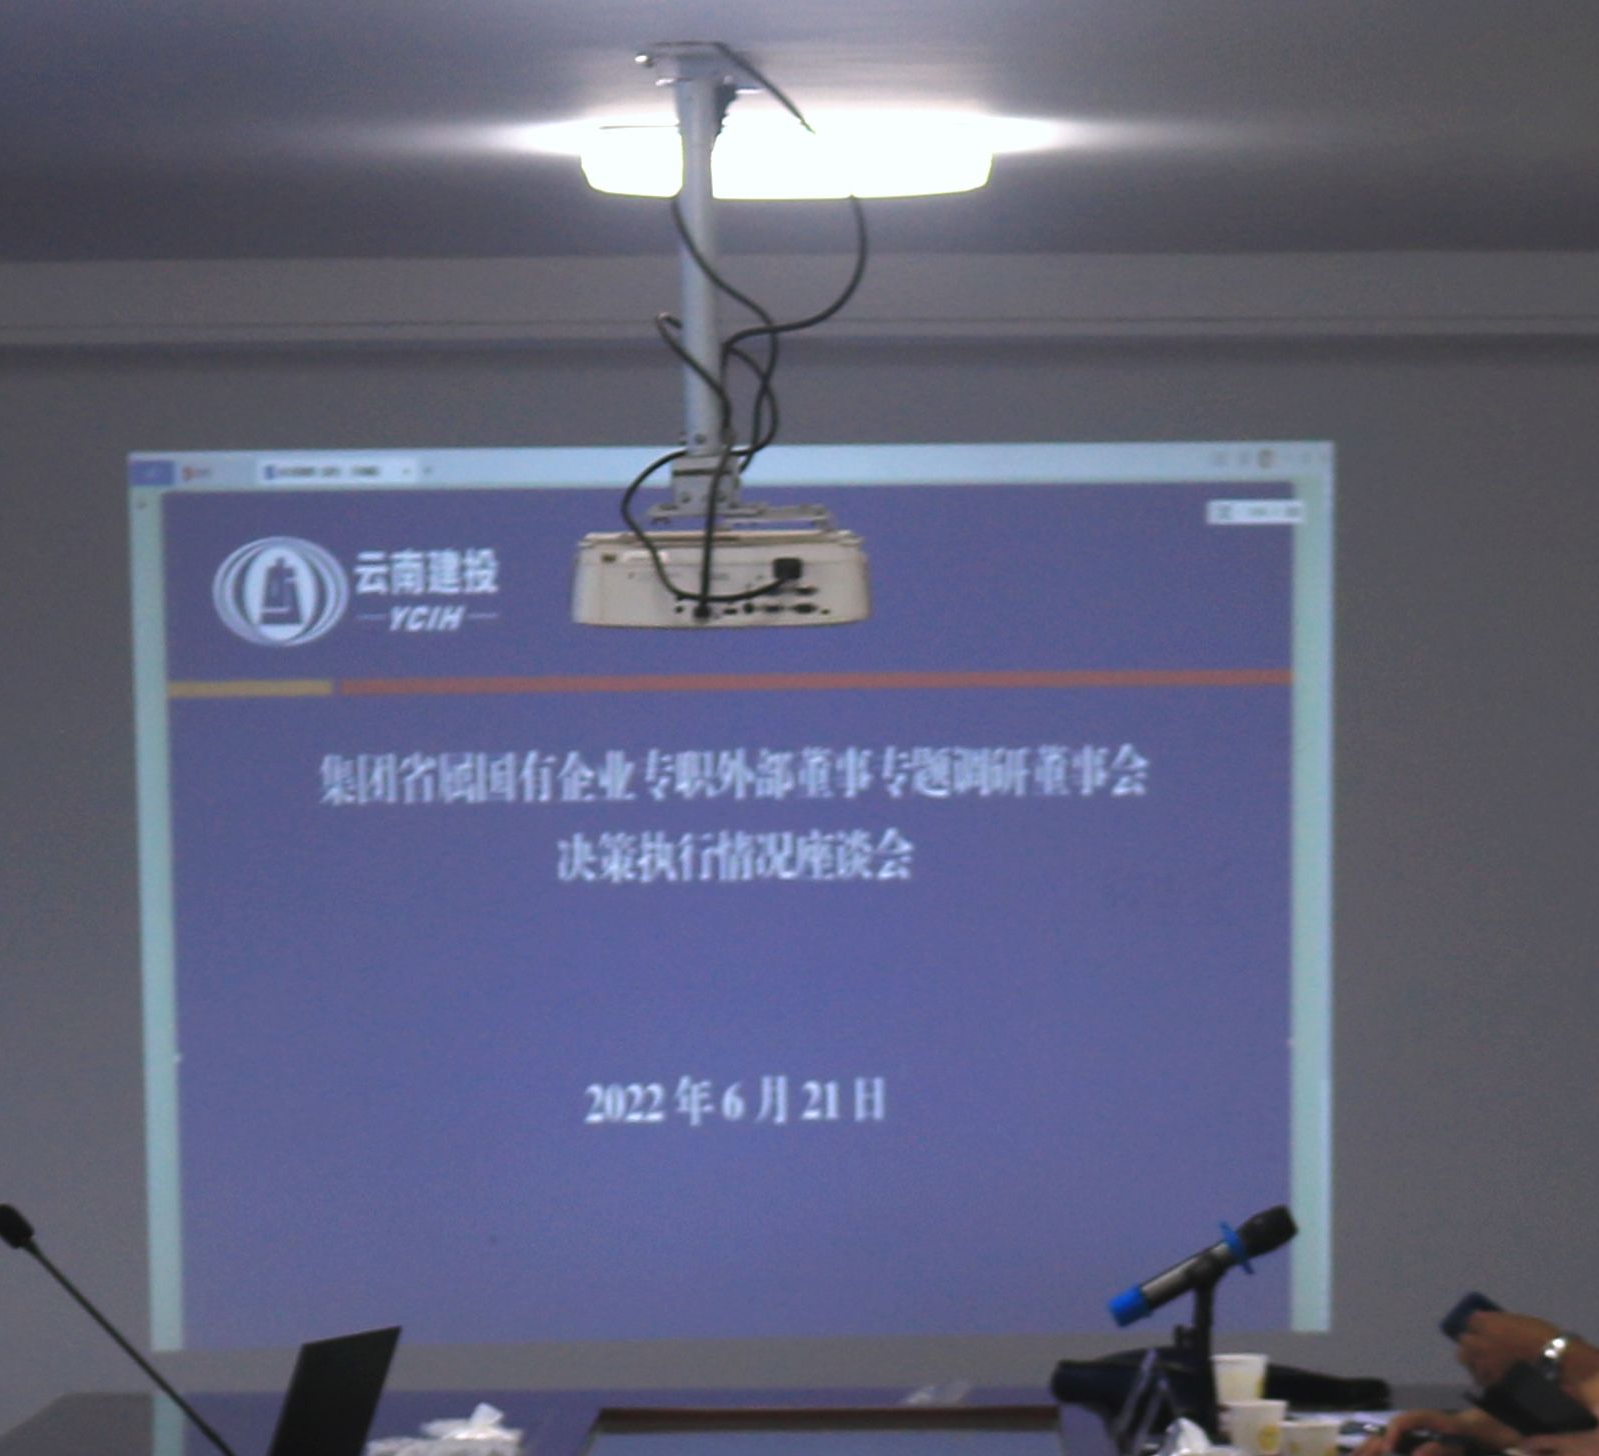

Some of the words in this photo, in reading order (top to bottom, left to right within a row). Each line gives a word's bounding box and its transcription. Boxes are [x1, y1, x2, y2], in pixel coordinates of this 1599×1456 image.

[354, 548, 499, 595] 云南建投
[389, 605, 466, 632] YCIH
[319, 743, 1150, 805] 集团省属国有企业专职外部董事专题调研董事会
[557, 825, 916, 883] 决策执行情况座谈会
[584, 1074, 887, 1126] 2022年6月21日
